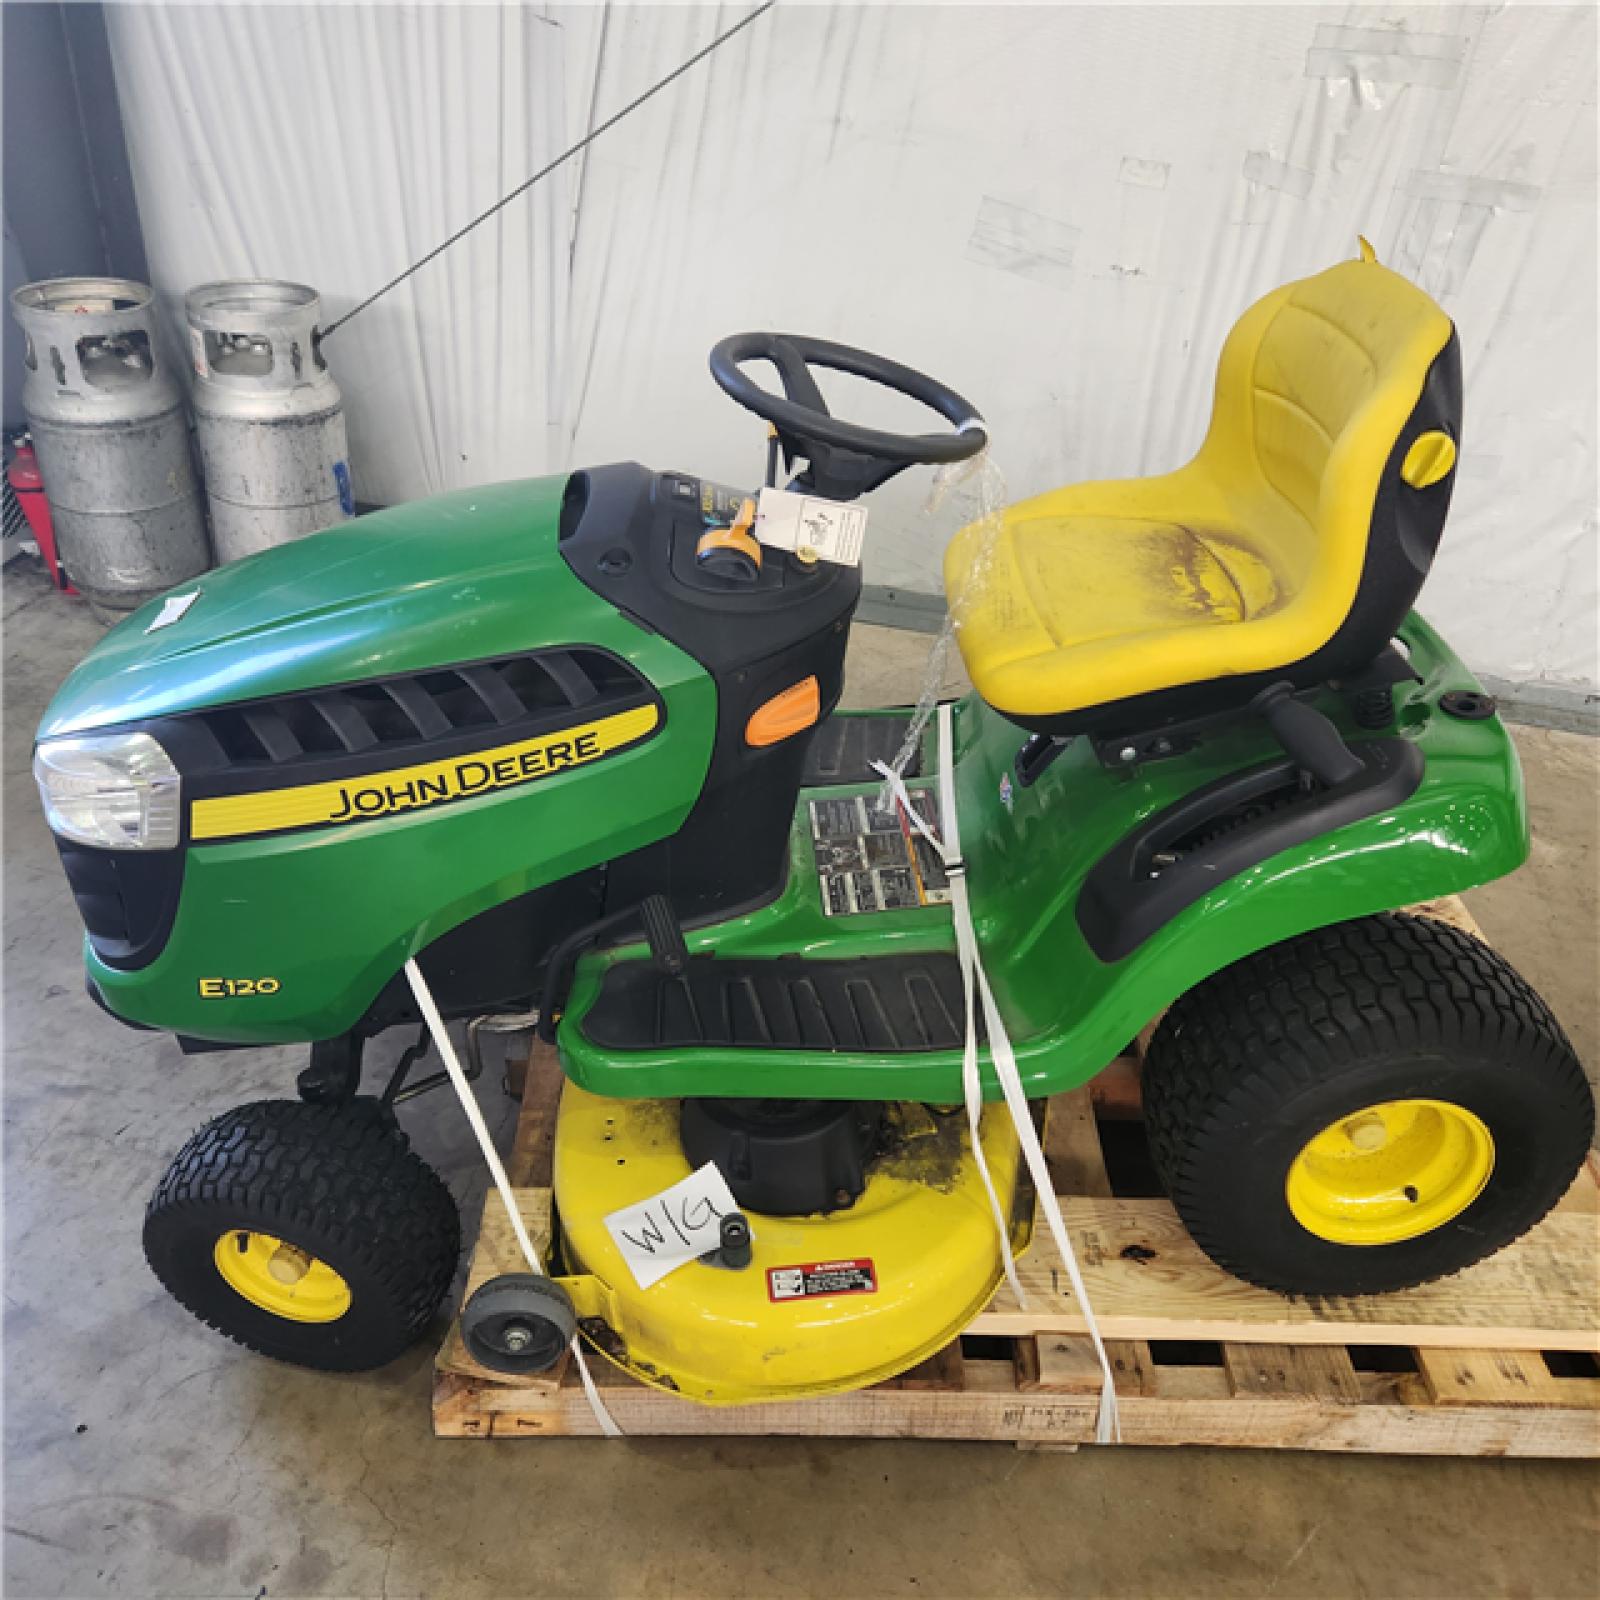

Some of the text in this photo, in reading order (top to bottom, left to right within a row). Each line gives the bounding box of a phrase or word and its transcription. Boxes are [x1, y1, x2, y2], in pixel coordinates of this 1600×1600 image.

[330, 732, 602, 819] JOHN DEERE
[199, 977, 280, 998] E120
